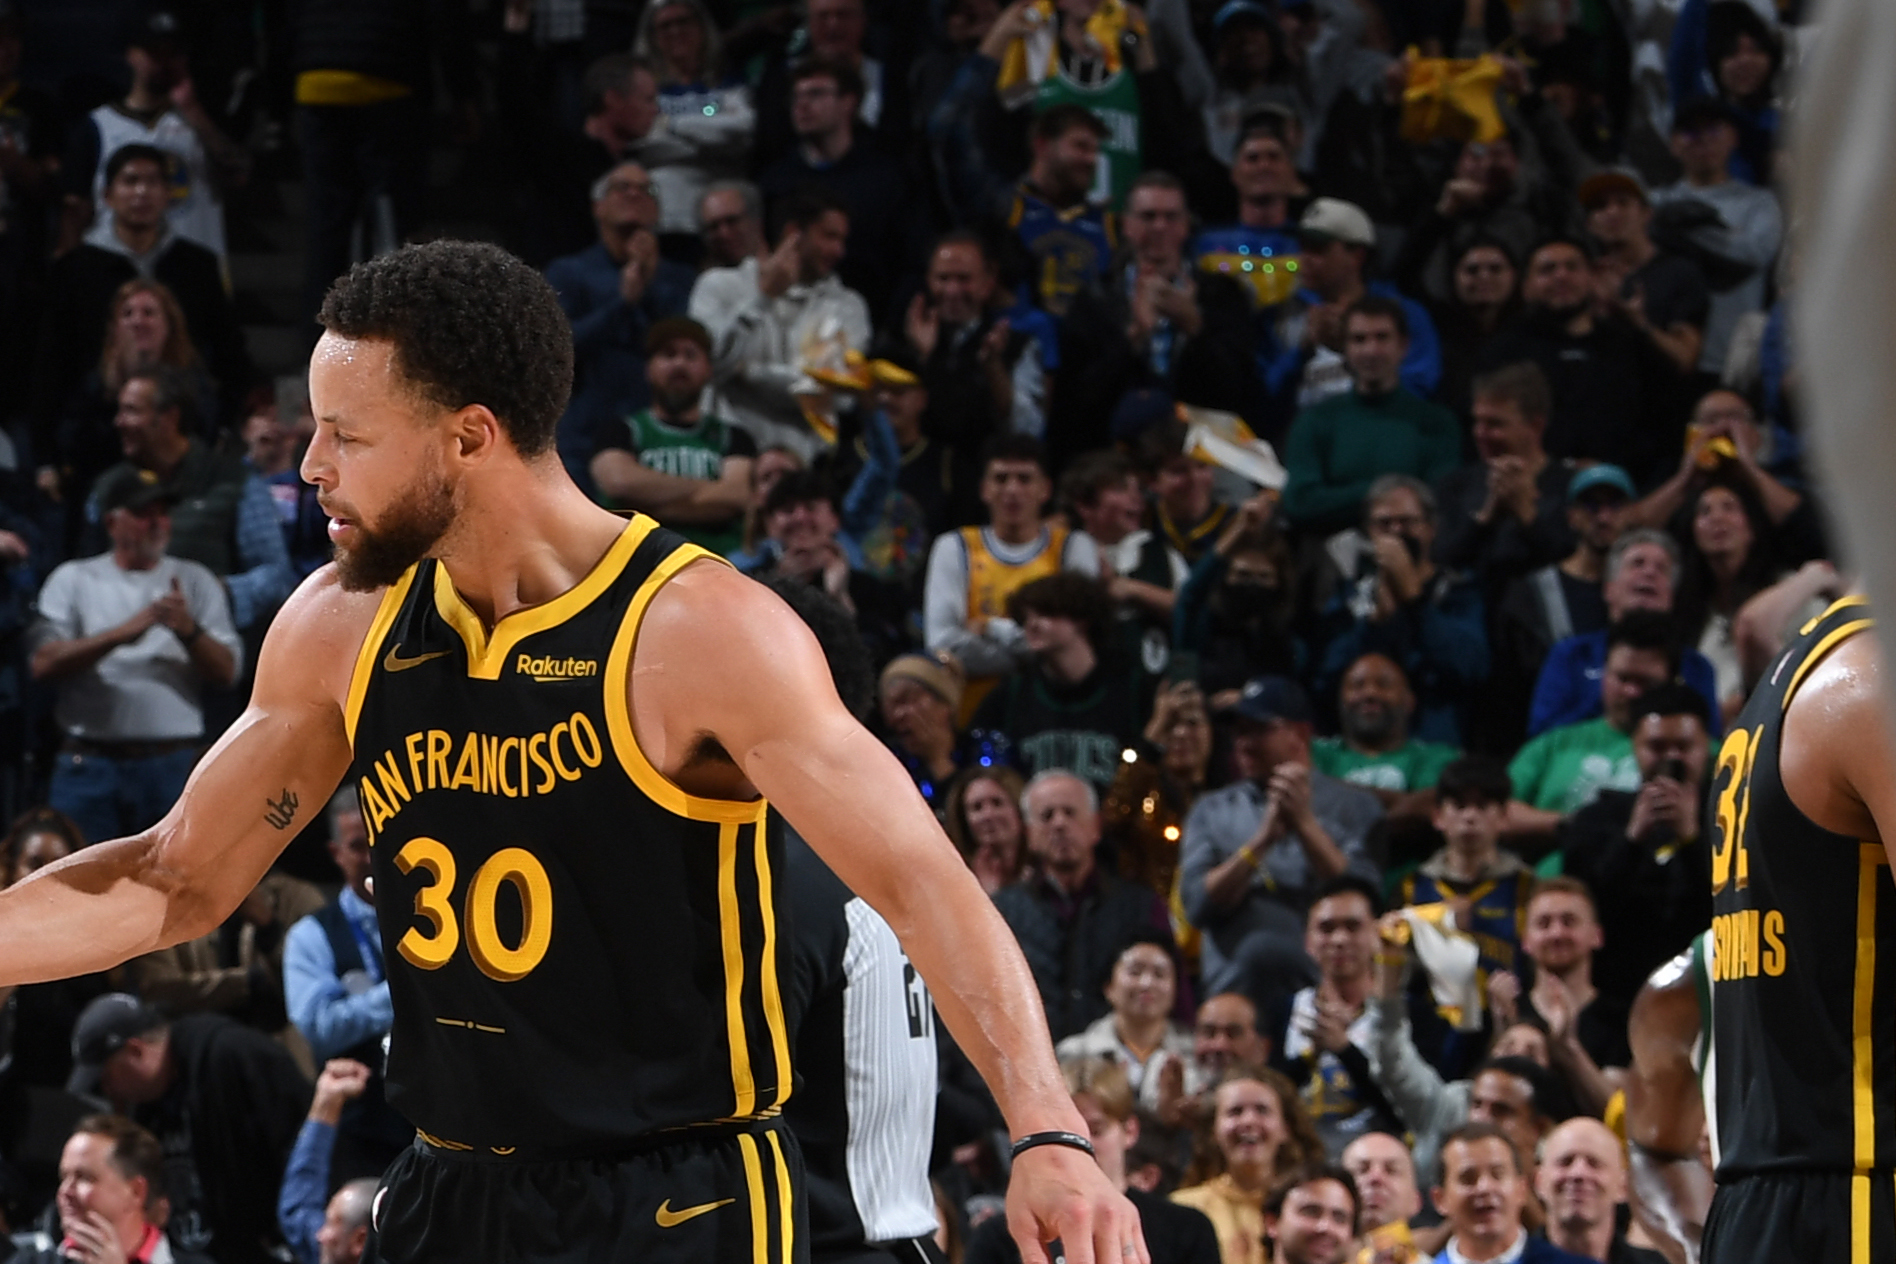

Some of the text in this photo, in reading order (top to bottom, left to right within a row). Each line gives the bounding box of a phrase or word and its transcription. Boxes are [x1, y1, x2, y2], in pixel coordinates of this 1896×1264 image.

[516, 653, 598, 677] Rakuten
[360, 711, 603, 848] AN FRANCISCO
[392, 836, 554, 984] 30
